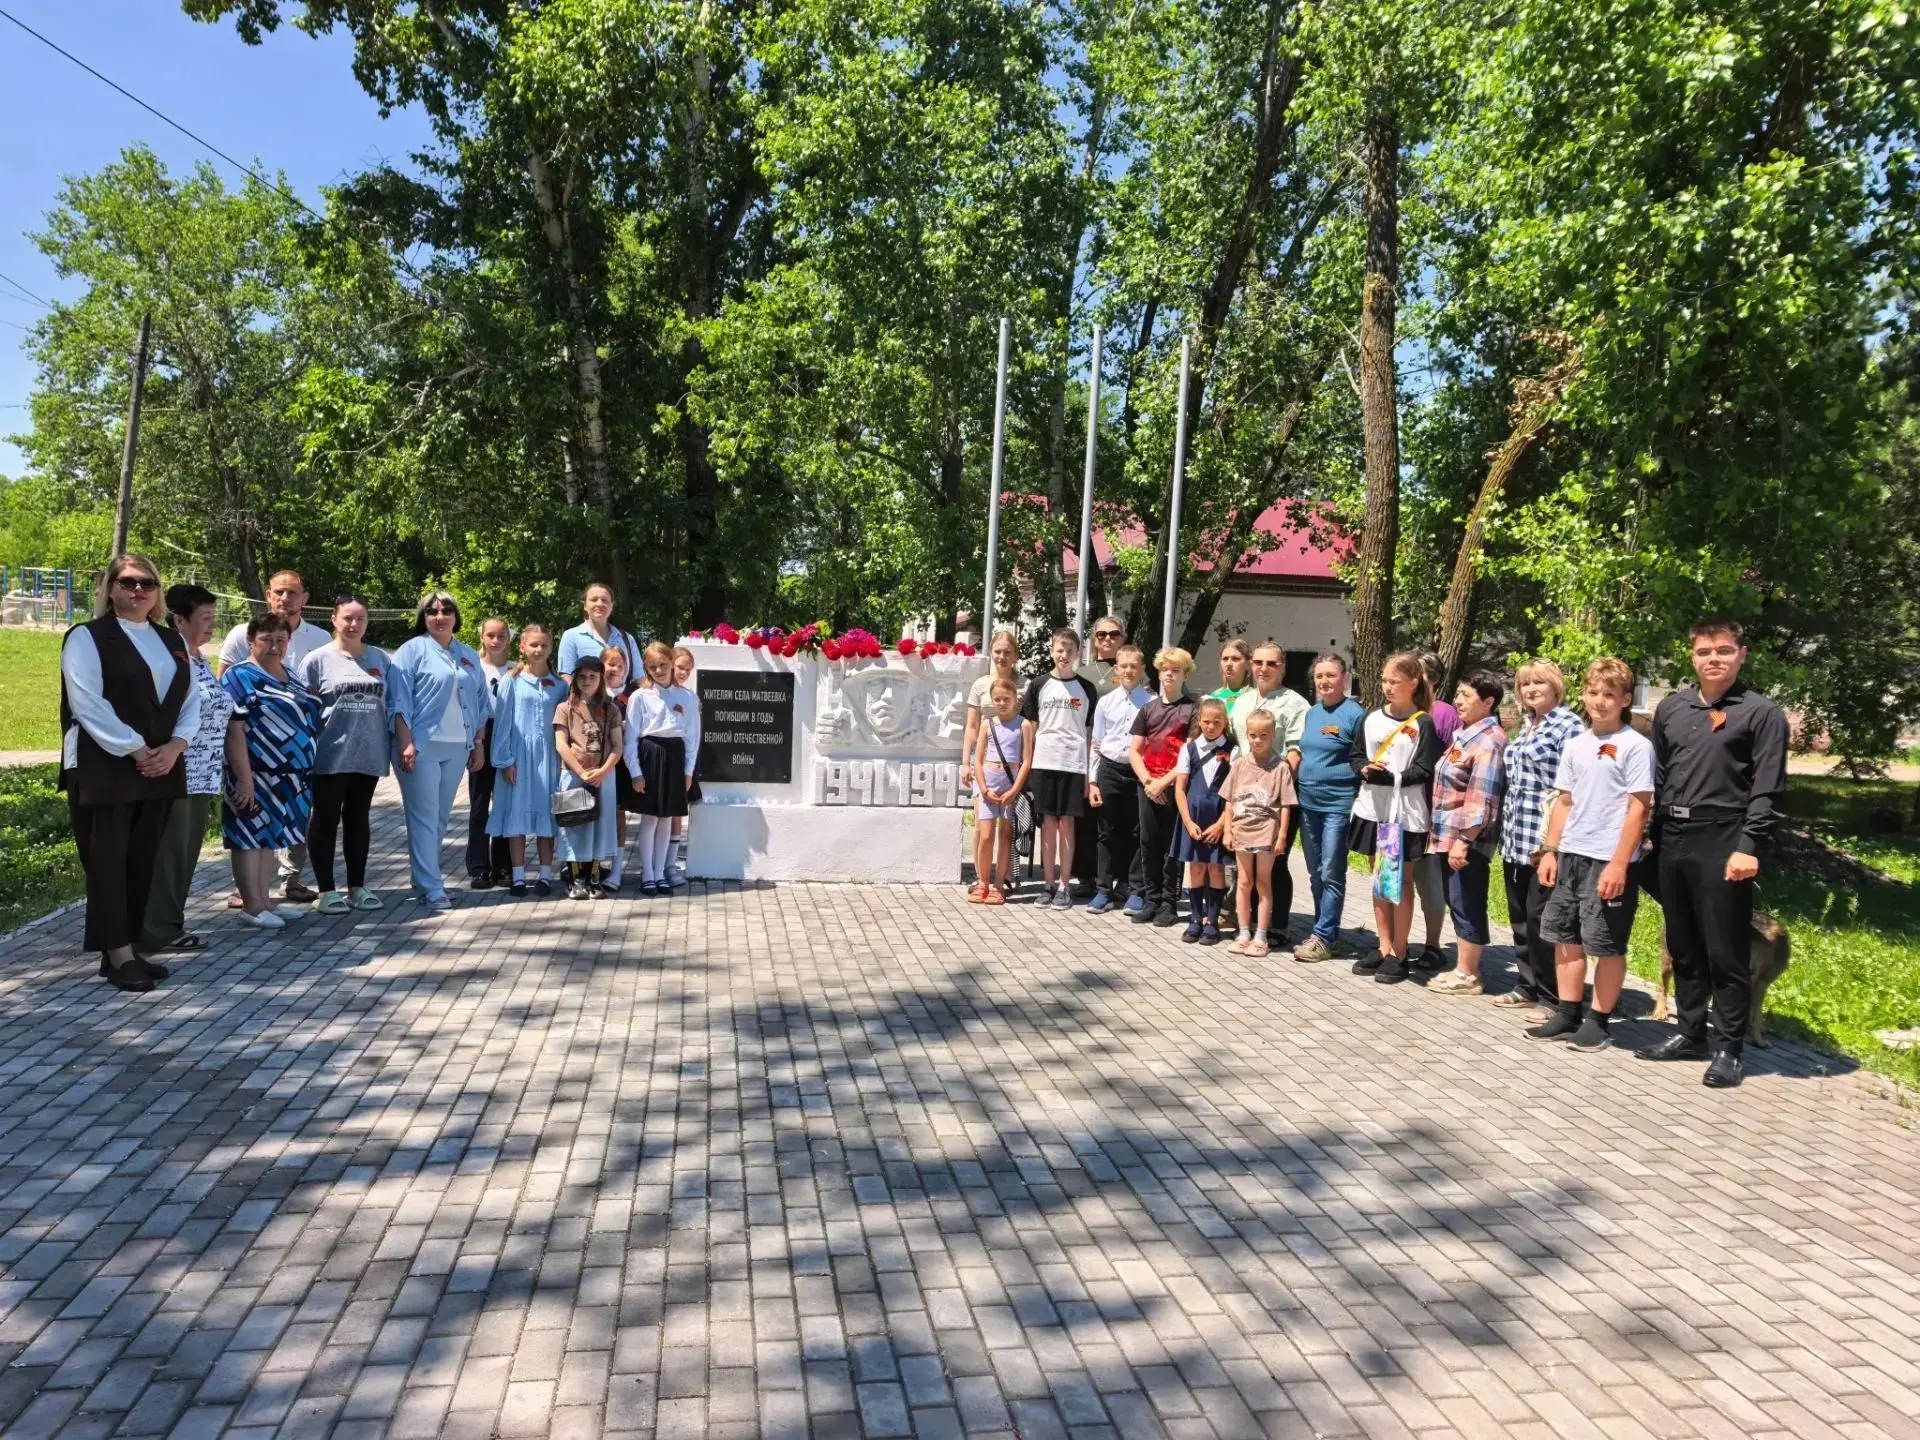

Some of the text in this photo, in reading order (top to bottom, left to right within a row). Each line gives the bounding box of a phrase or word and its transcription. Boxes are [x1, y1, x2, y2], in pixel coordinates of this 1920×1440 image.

[703, 689, 786, 702] ЖИТЕЛЯМ СЕЛА МАТВЕЕВКА
[715, 711, 774, 724] ПОГИБШИМ В ГОДЫ
[704, 730, 783, 744] ВЕЛИКОЙ ОТЕЧЕСТВЕННОЙ
[732, 752, 754, 765] ВОЙНЫ
[813, 758, 886, 806] 1941
